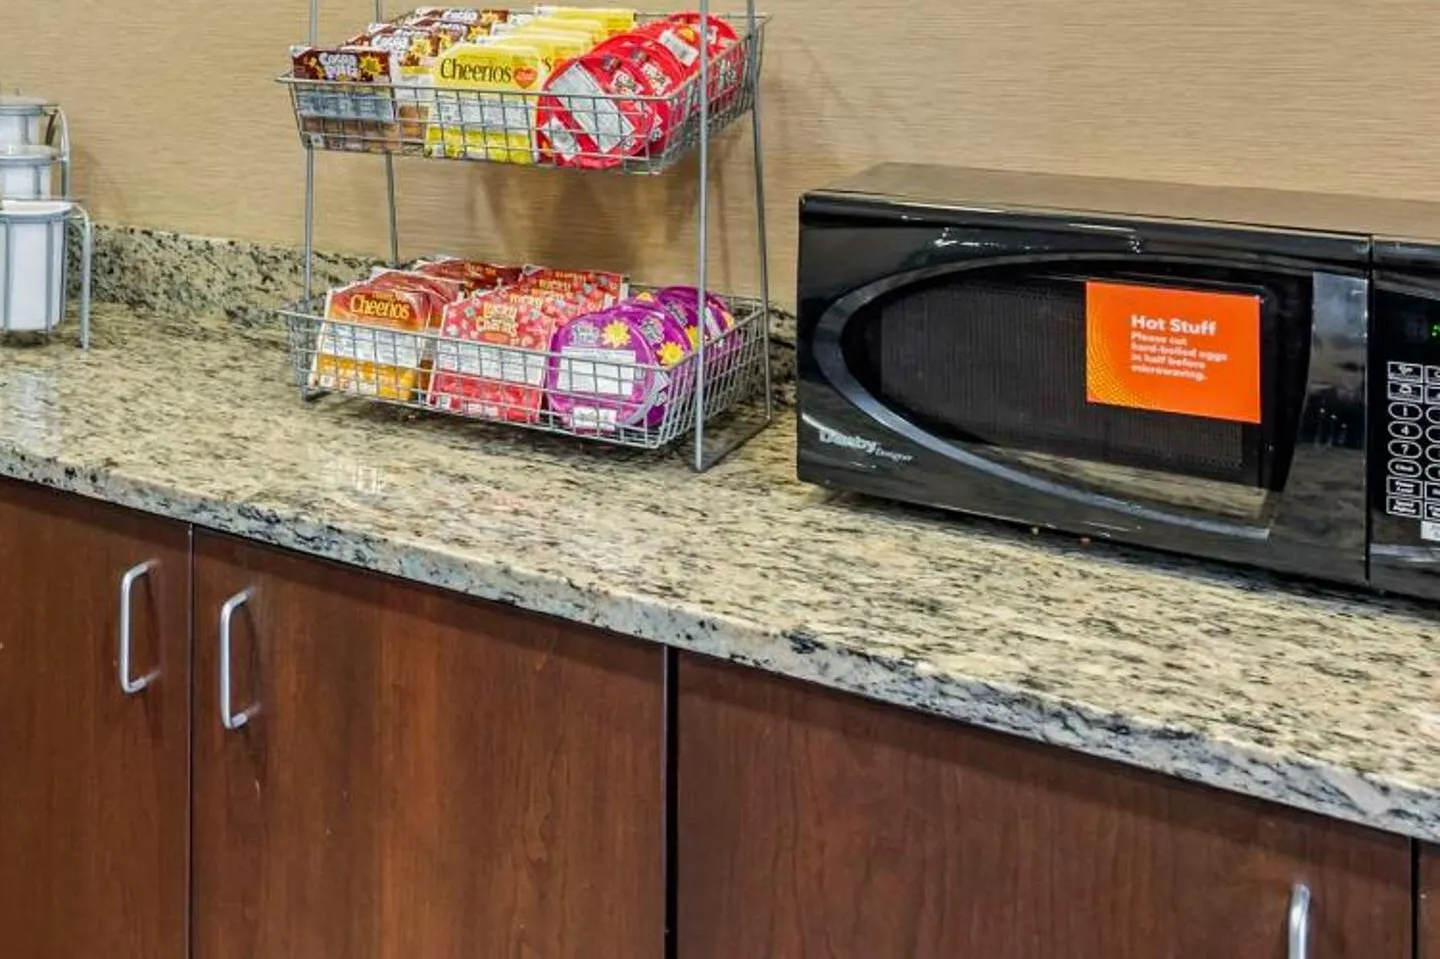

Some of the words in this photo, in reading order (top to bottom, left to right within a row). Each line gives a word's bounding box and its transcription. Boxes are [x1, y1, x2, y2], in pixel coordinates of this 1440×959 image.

[440, 57, 512, 84] Cheerios
[350, 293, 410, 320] Cheerios
[1131, 314, 1166, 331] Hot
[1169, 318, 1217, 336] Stuff
[1130, 331, 1167, 344] Please
[1169, 335, 1188, 346] cut
[1130, 343, 1198, 359] hard-boiled
[1199, 351, 1228, 363] eggs
[1131, 353, 1143, 363] in
[1145, 353, 1166, 365] half
[1168, 356, 1206, 370] before
